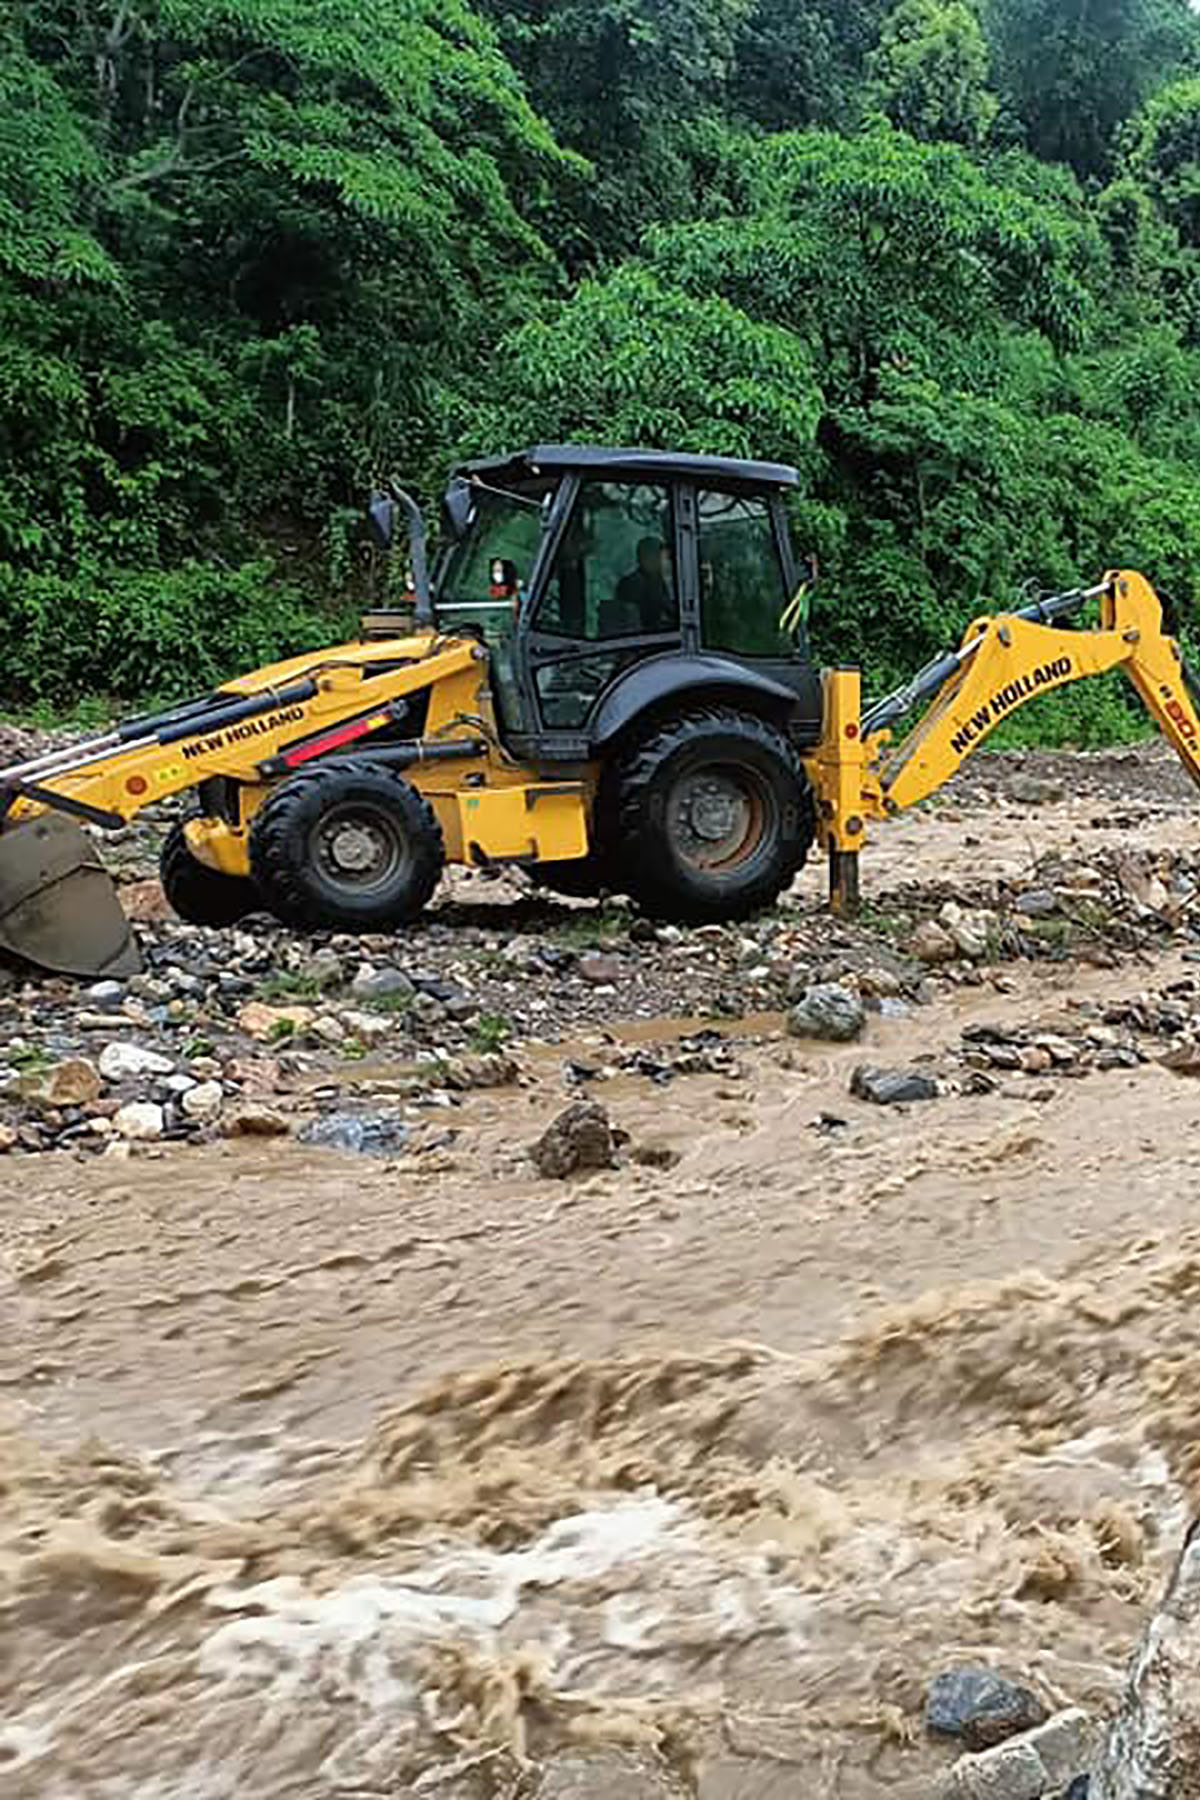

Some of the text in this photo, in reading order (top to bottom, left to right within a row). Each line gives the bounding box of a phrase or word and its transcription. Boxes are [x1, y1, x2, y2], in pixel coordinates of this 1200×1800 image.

[182, 707, 304, 759] NEW HOLLAND
[950, 656, 1072, 754] NEW HOLLAND
